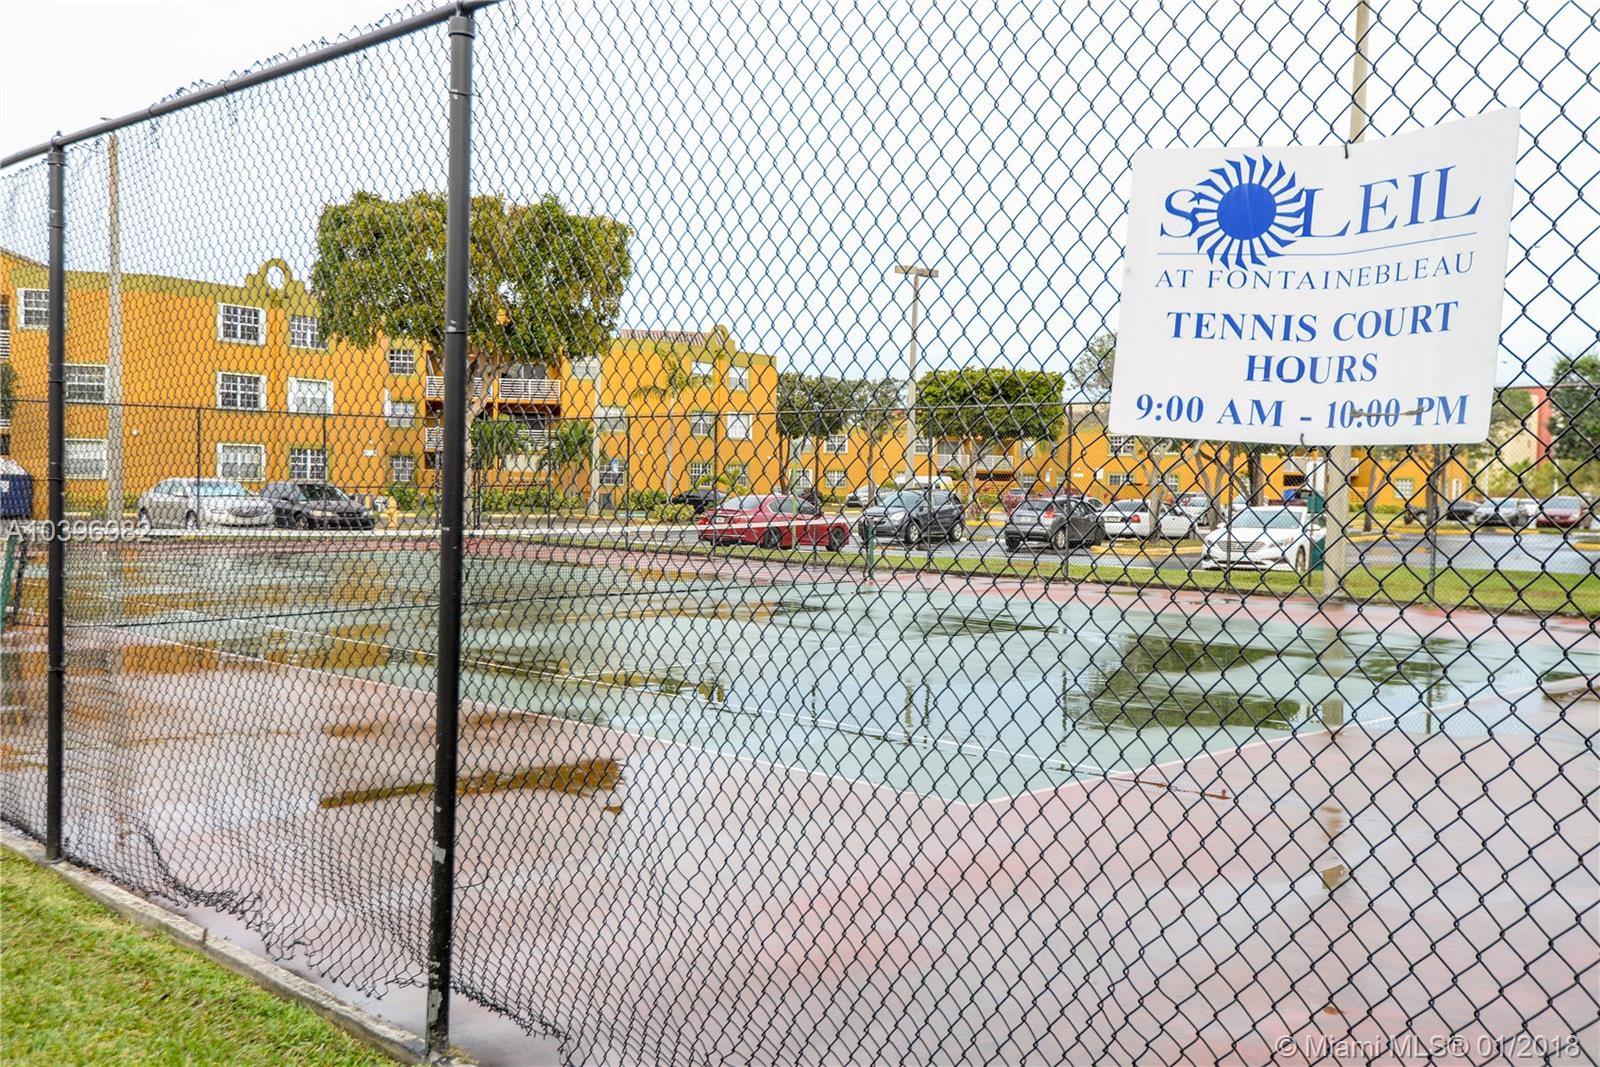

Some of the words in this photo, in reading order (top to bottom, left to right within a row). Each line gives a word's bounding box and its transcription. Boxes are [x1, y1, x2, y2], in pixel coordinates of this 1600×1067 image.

[1155, 269, 1193, 288] AT
[1208, 251, 1474, 290] FONTAINEBLEAU
[1167, 312, 1317, 342] TENNIS
[1333, 301, 1459, 341] COURT
[1244, 353, 1378, 383] HOURS
[1136, 394, 1204, 422] 9:00
[1217, 398, 1284, 427] AM
[1327, 398, 1400, 429] 10:00
[1414, 394, 1470, 426] PM
